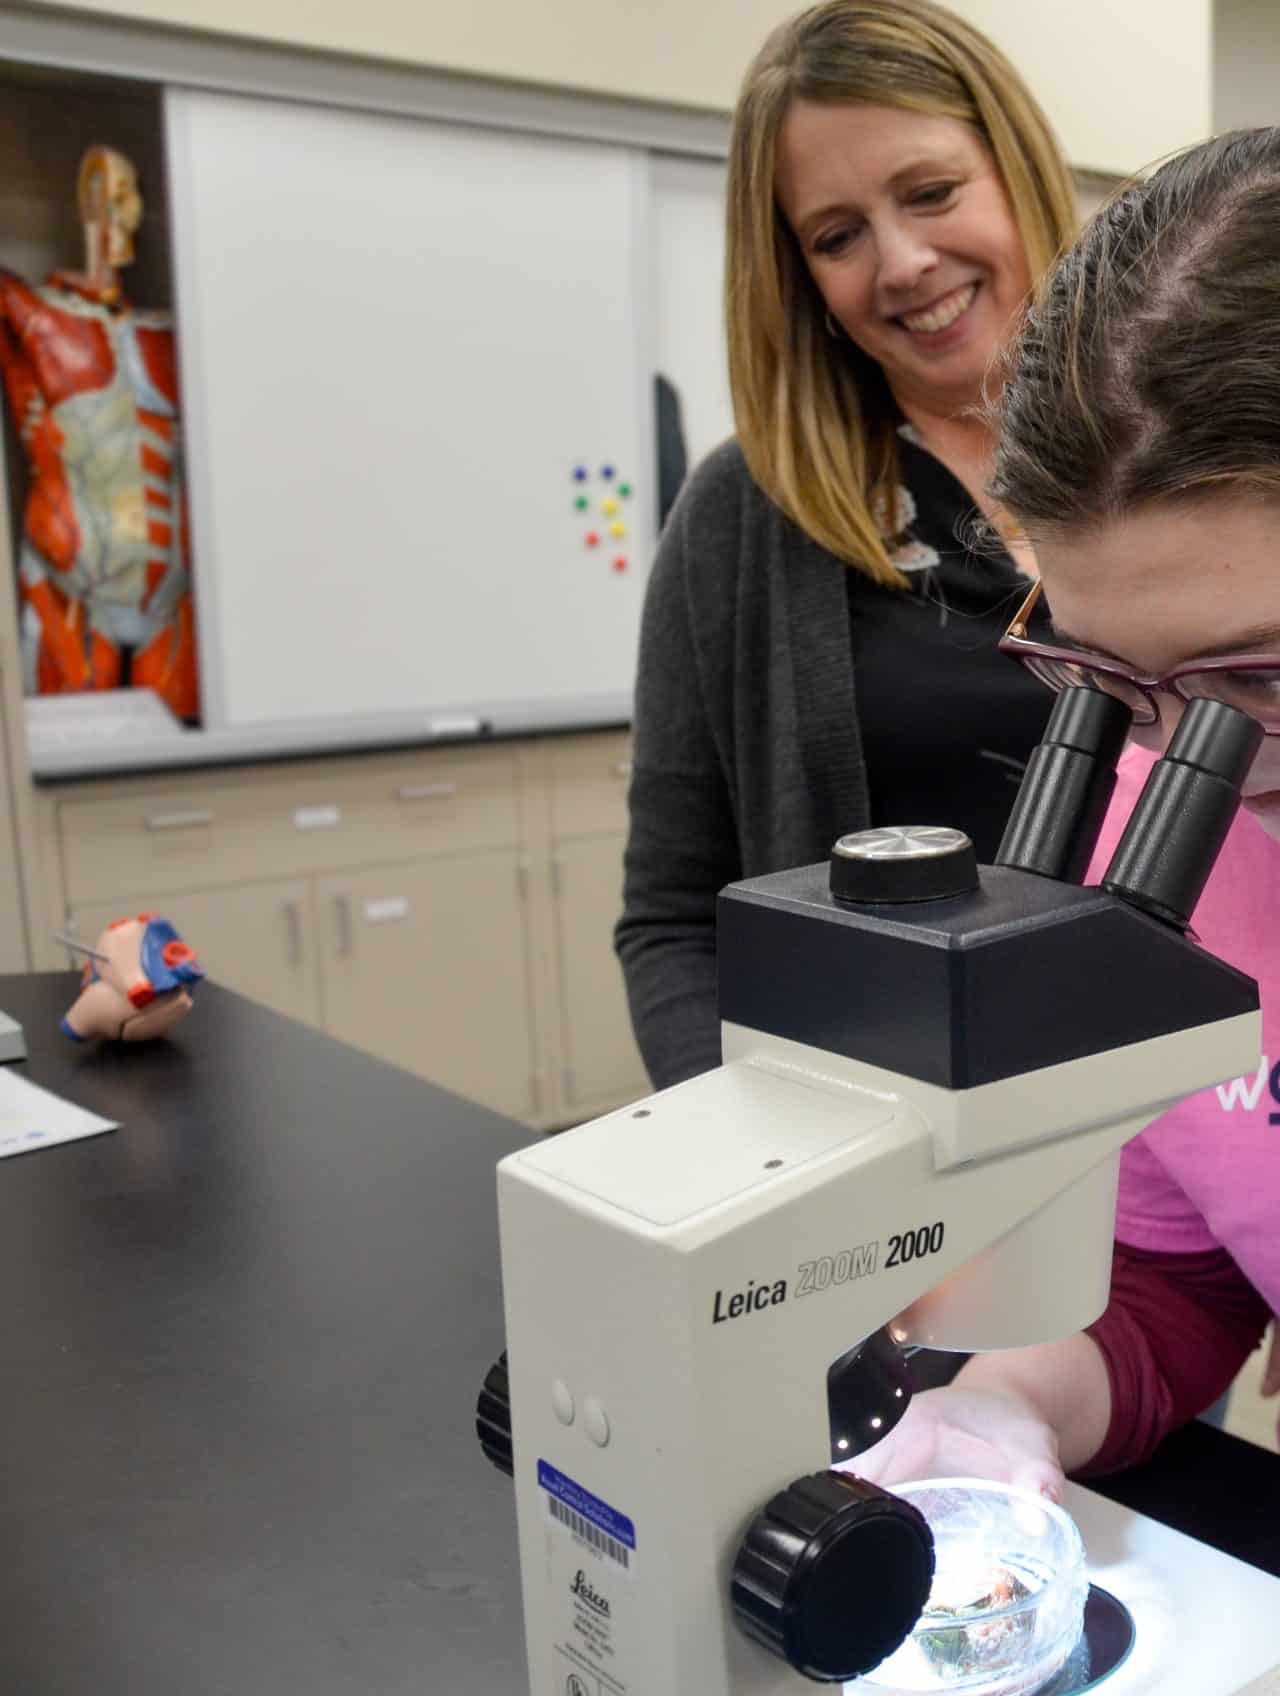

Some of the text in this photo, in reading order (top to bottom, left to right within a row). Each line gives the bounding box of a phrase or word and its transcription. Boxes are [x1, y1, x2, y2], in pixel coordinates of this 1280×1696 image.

[712, 1221, 945, 1325] Leica ZOOM 2000
